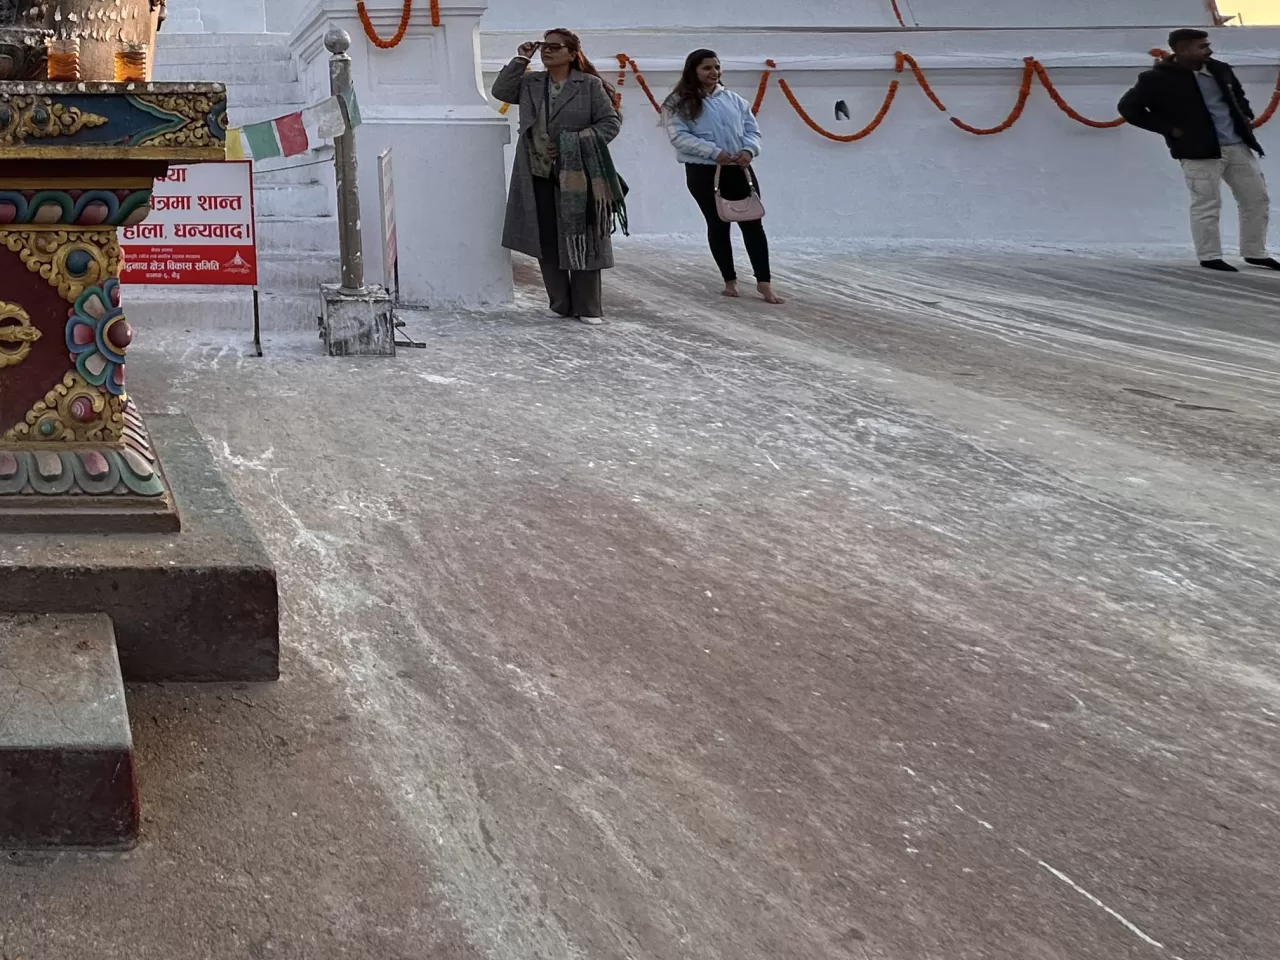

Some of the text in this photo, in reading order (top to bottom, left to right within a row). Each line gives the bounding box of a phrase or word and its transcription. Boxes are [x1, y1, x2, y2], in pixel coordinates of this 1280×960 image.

[197, 195, 242, 211] शान्त
[150, 259, 165, 270] क्षेत्र
[167, 259, 192, 270] विकास
[195, 259, 219, 271] समिति
